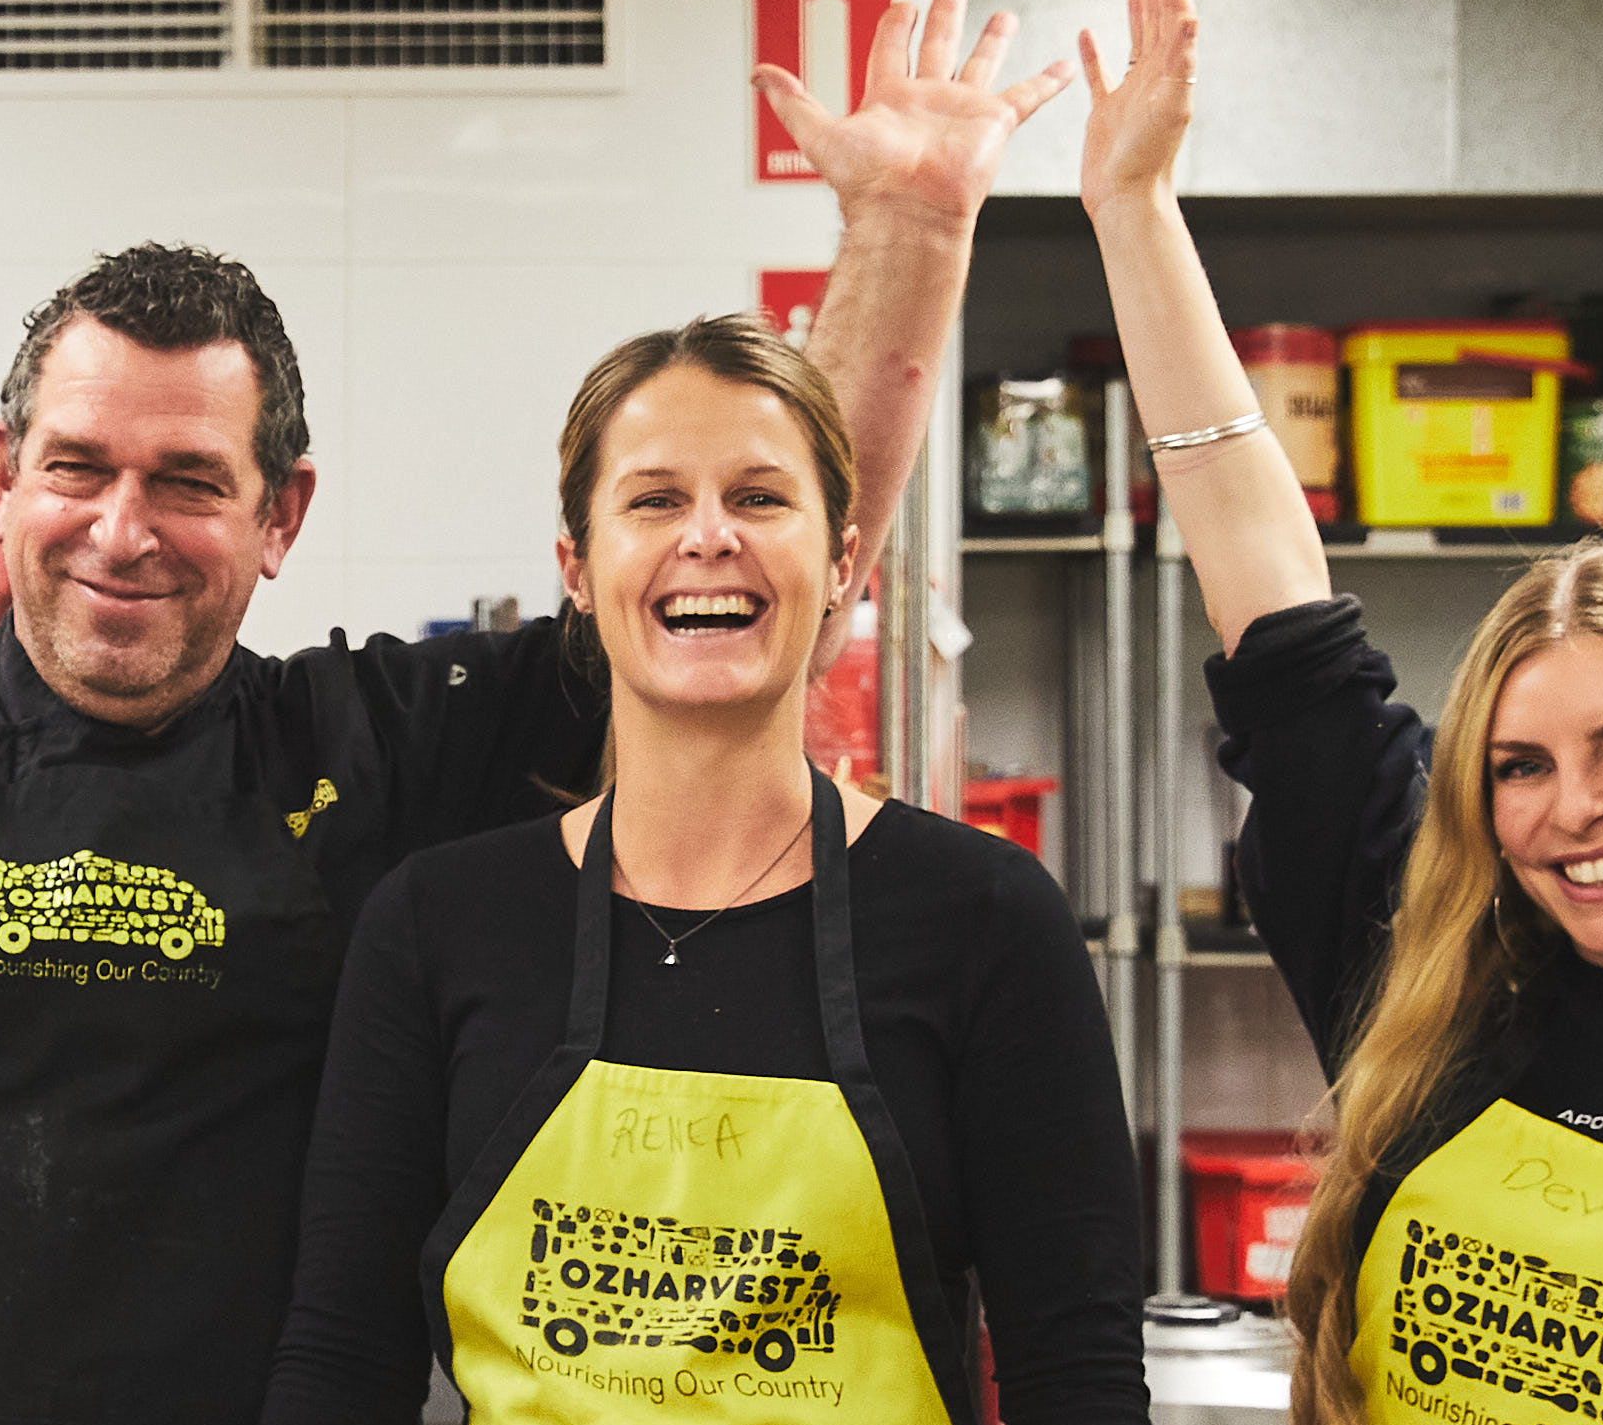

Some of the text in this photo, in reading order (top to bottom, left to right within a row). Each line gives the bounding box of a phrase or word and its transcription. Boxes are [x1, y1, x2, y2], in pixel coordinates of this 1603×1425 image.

[8, 883, 188, 912] OZHARVEST
[96, 958, 136, 982] Our
[141, 959, 223, 990] Country
[560, 1258, 805, 1305] OZHARVEST
[515, 1343, 845, 1407] Nourishing Our Country
